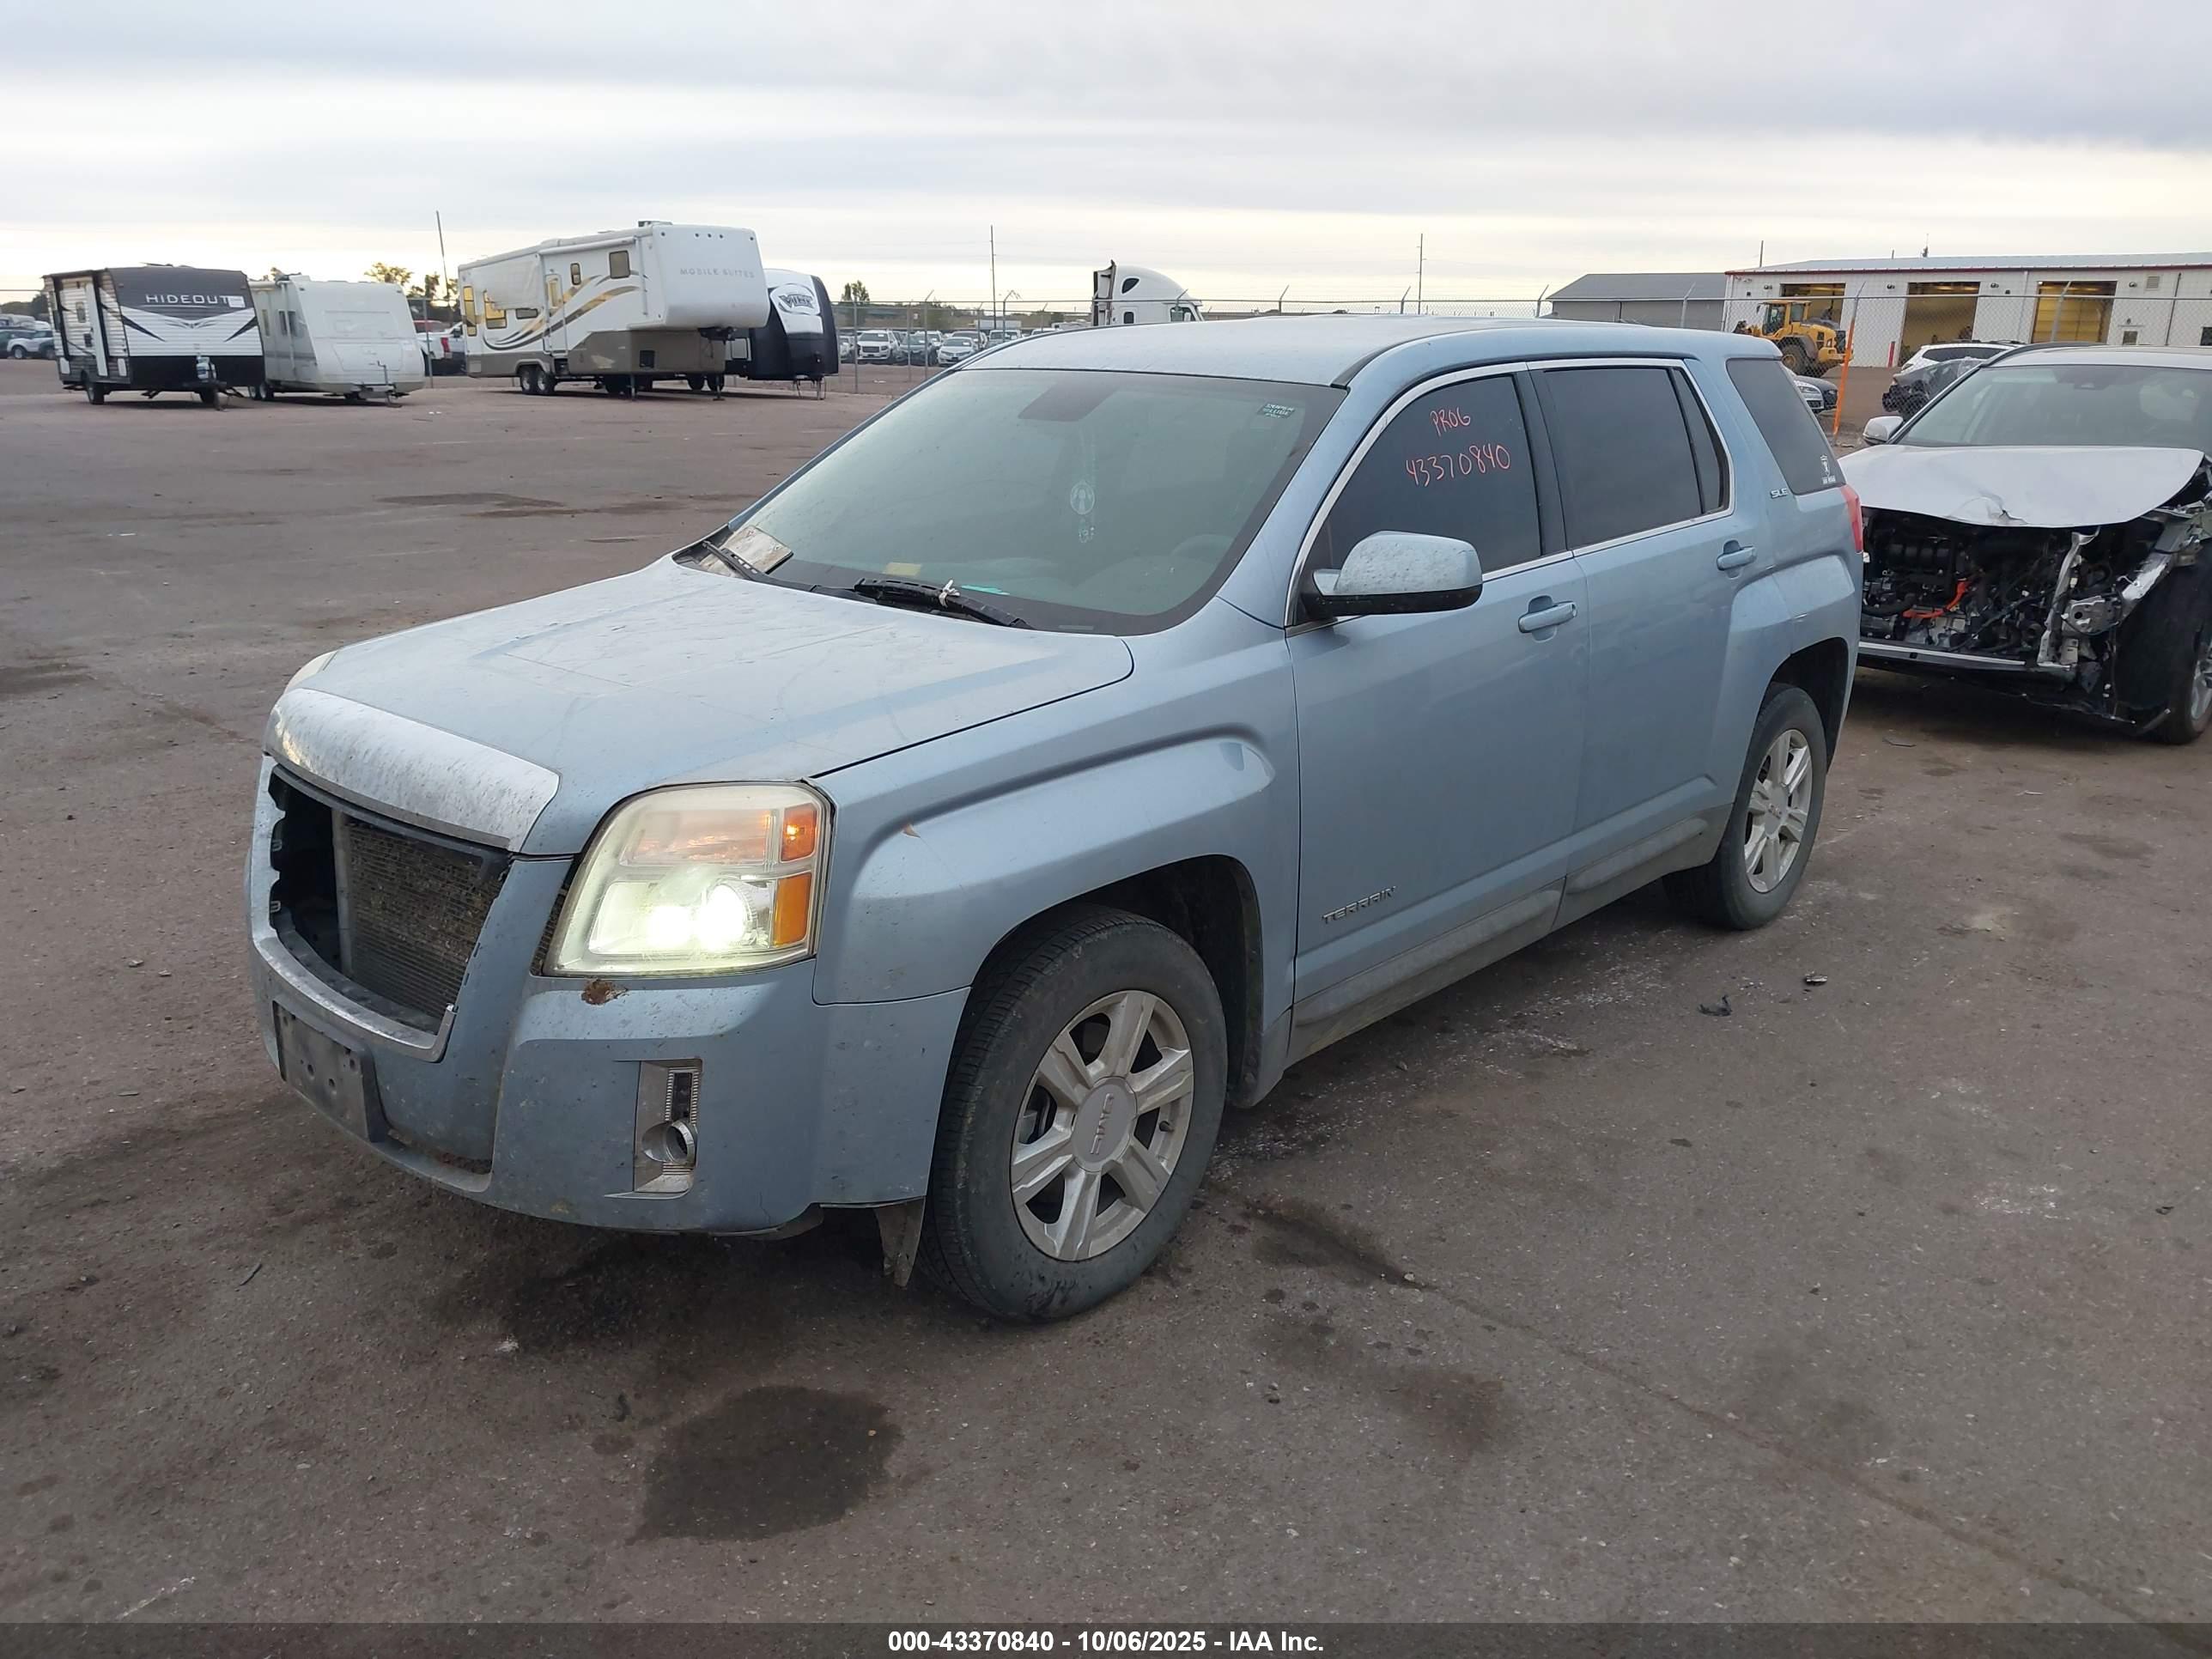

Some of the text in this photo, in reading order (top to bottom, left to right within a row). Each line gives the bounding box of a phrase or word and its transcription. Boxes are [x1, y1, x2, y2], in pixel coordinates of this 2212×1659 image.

[145, 294, 229, 305] HIDEOUT
[1405, 442, 1511, 488] 43370840
[1770, 487, 1790, 499] SLE
[1322, 885, 1397, 925] TERRAIN
